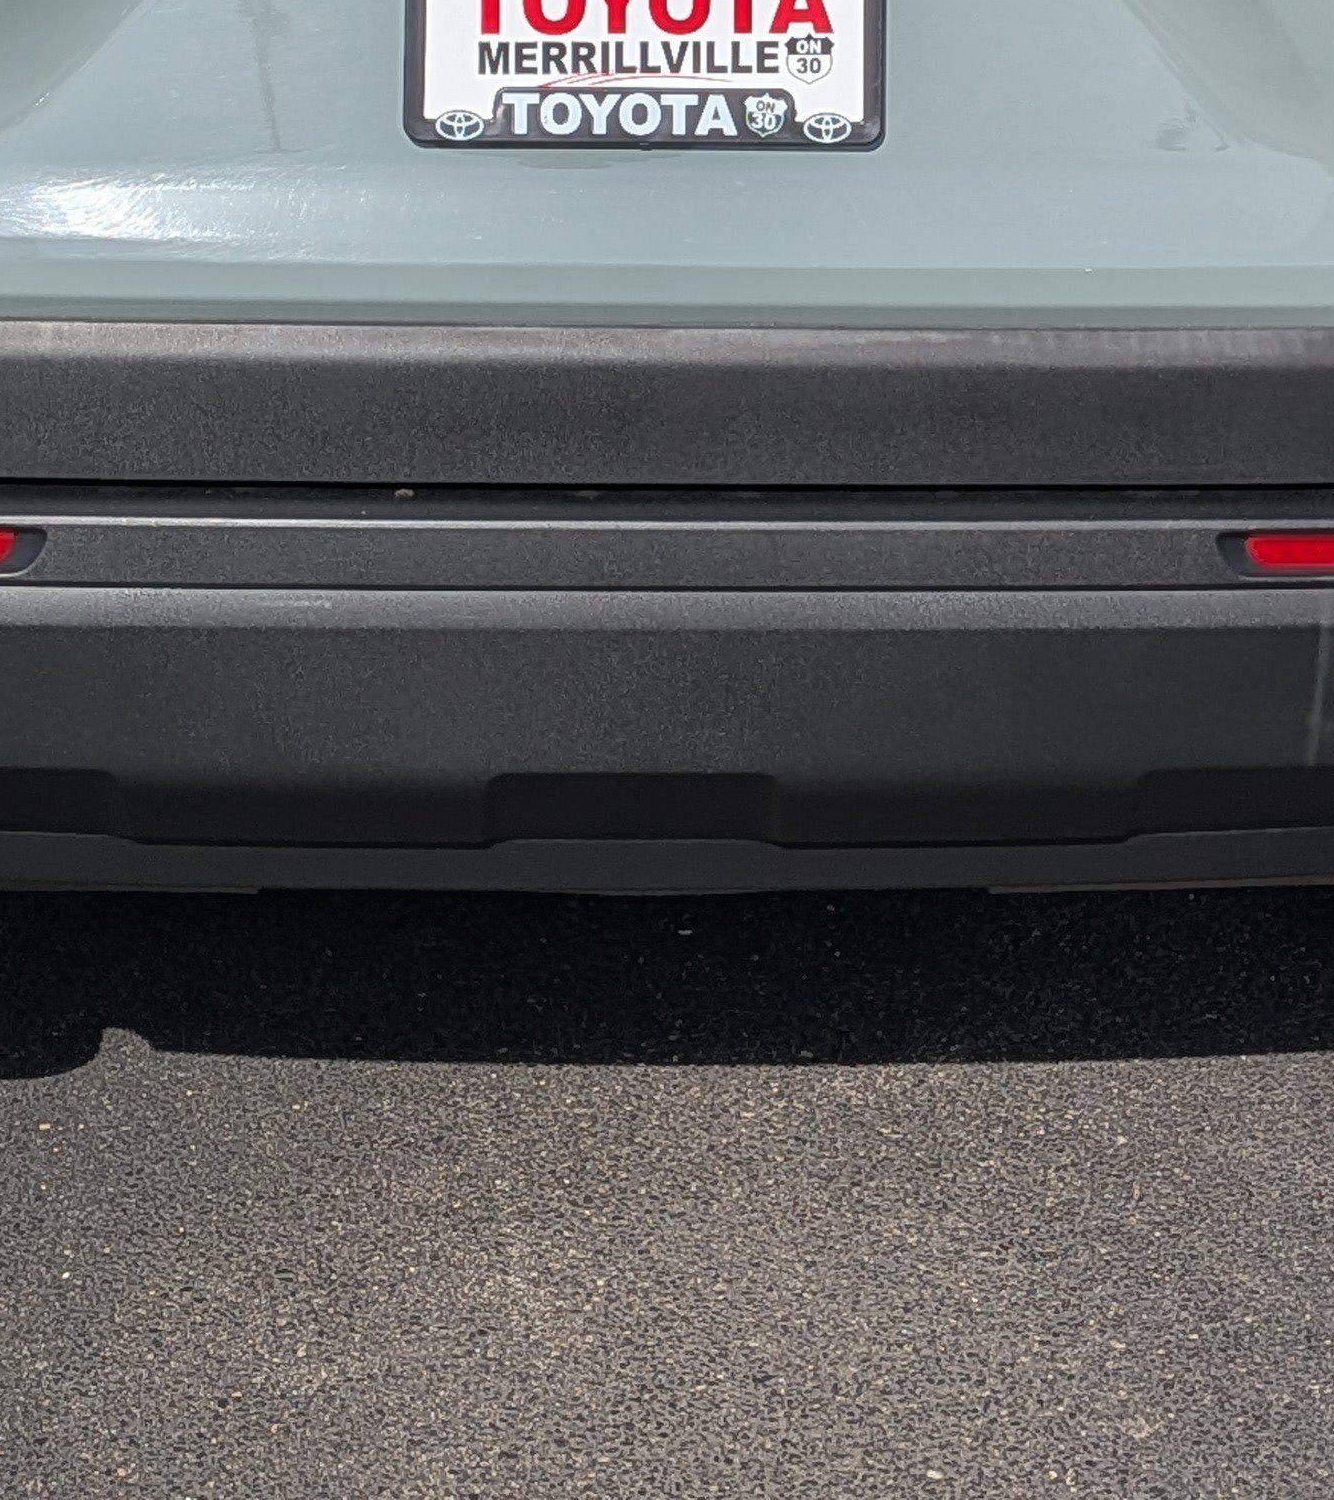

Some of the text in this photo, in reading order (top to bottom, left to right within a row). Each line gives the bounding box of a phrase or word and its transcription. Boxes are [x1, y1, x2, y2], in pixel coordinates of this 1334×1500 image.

[795, 38, 822, 55] ON
[478, 40, 781, 75] MERRILLVILLE
[796, 57, 822, 74] 30
[501, 92, 738, 137] TOYOTA
[756, 100, 776, 114] ON
[750, 112, 777, 131] 30
